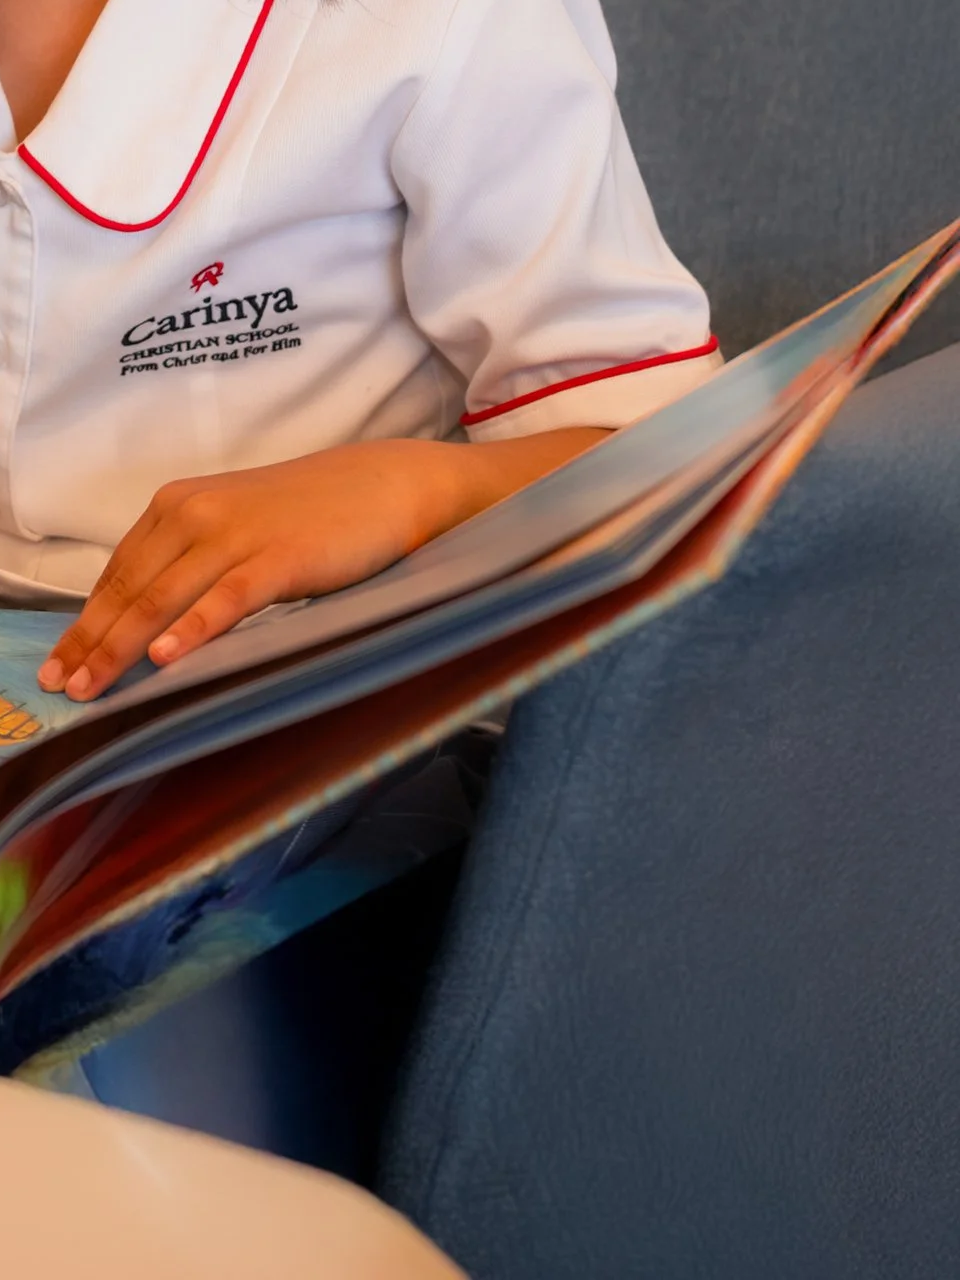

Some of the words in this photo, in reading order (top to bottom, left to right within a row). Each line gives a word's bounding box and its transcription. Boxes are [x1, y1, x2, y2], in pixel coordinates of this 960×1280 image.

[120, 286, 298, 347] Carinya
[119, 336, 220, 363] CHRISTIAN
[225, 323, 299, 345] SCHOOL
[120, 362, 158, 376] From
[162, 353, 208, 369] Christ
[211, 349, 240, 362] and
[243, 344, 268, 358] For
[271, 337, 302, 352] Him
